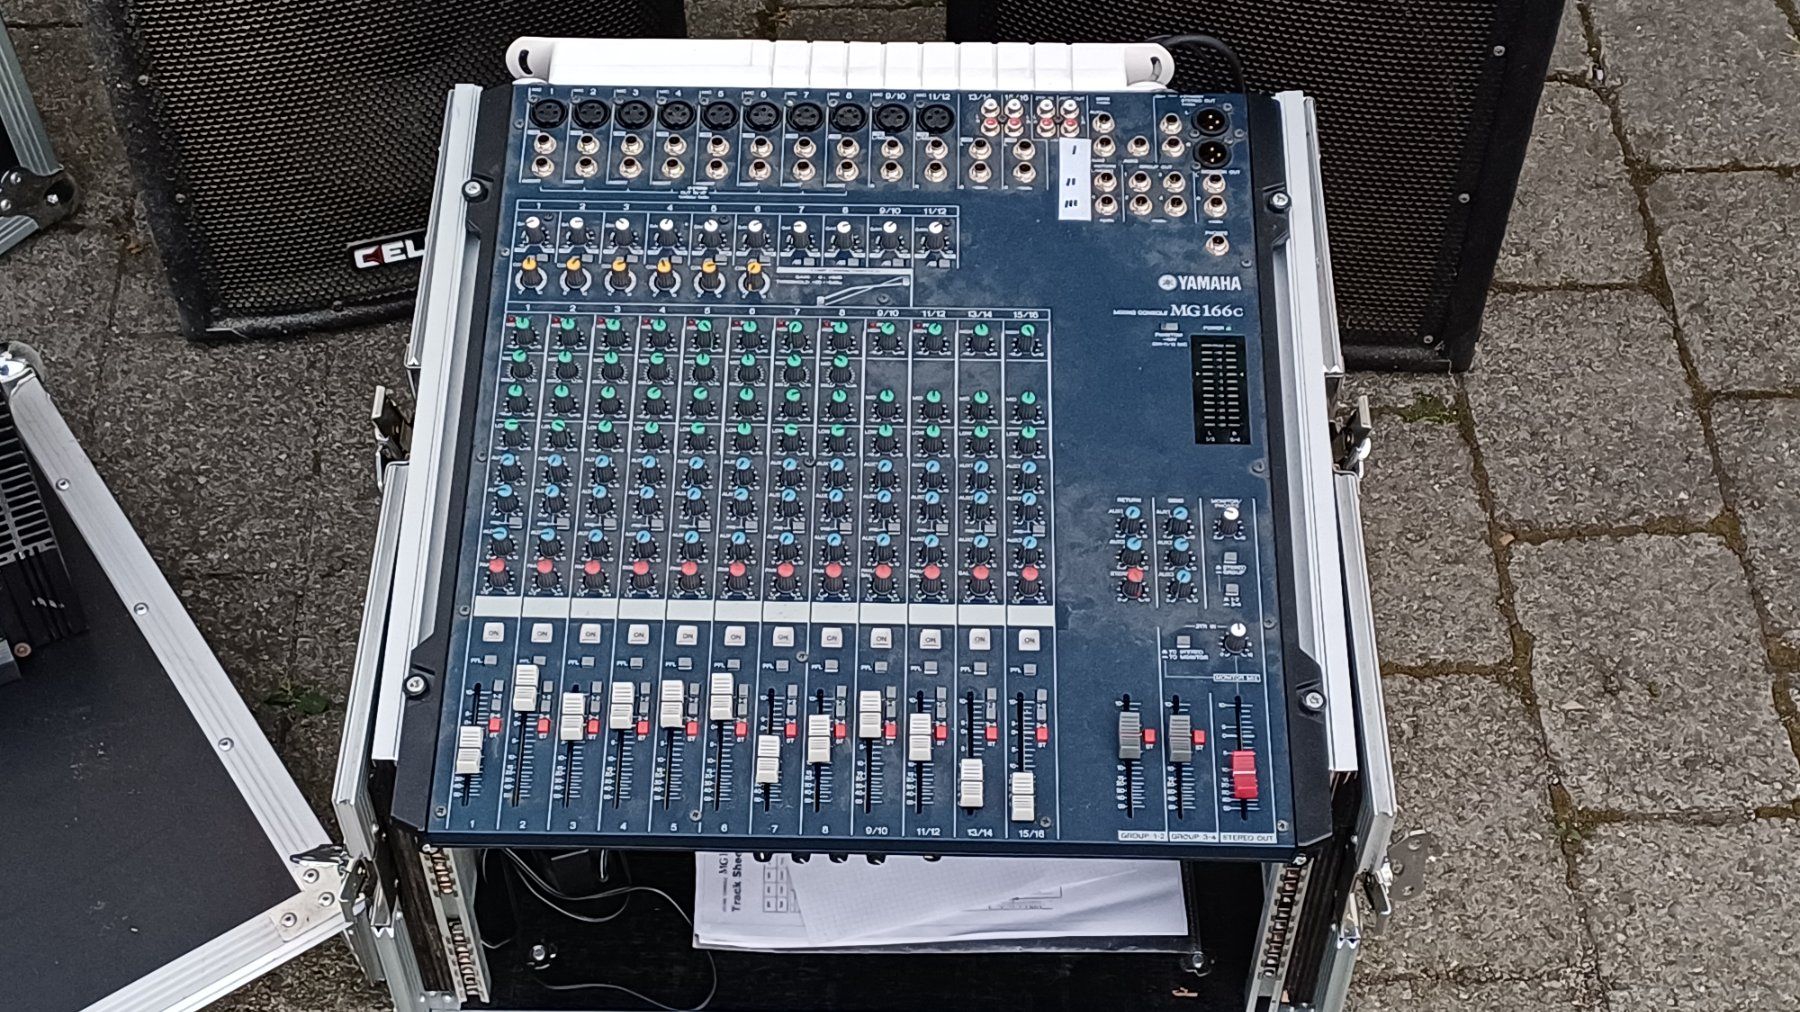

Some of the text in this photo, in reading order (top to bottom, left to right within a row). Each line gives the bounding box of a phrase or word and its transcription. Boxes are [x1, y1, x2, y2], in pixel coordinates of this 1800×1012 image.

[590, 88, 597, 96] 2
[632, 88, 639, 96] 3
[674, 89, 681, 97] 4
[885, 92, 906, 100] 9/10
[924, 207, 947, 215] 11/12
[1178, 275, 1242, 290] YAMAHA
[659, 306, 666, 314] 4
[1170, 304, 1244, 317] MG166c
[470, 820, 475, 828] 1
[519, 821, 526, 829] 2
[569, 821, 577, 830] 3
[620, 822, 627, 830] 4
[670, 822, 677, 831] 5
[721, 823, 728, 832] 6
[771, 825, 778, 833] 7
[822, 825, 829, 834] 8
[866, 826, 888, 835] 9/10
[917, 828, 941, 836] 11/12
[967, 828, 993, 837] 13/14
[1019, 830, 1045, 838] 15/16
[731, 881, 742, 912] Track
